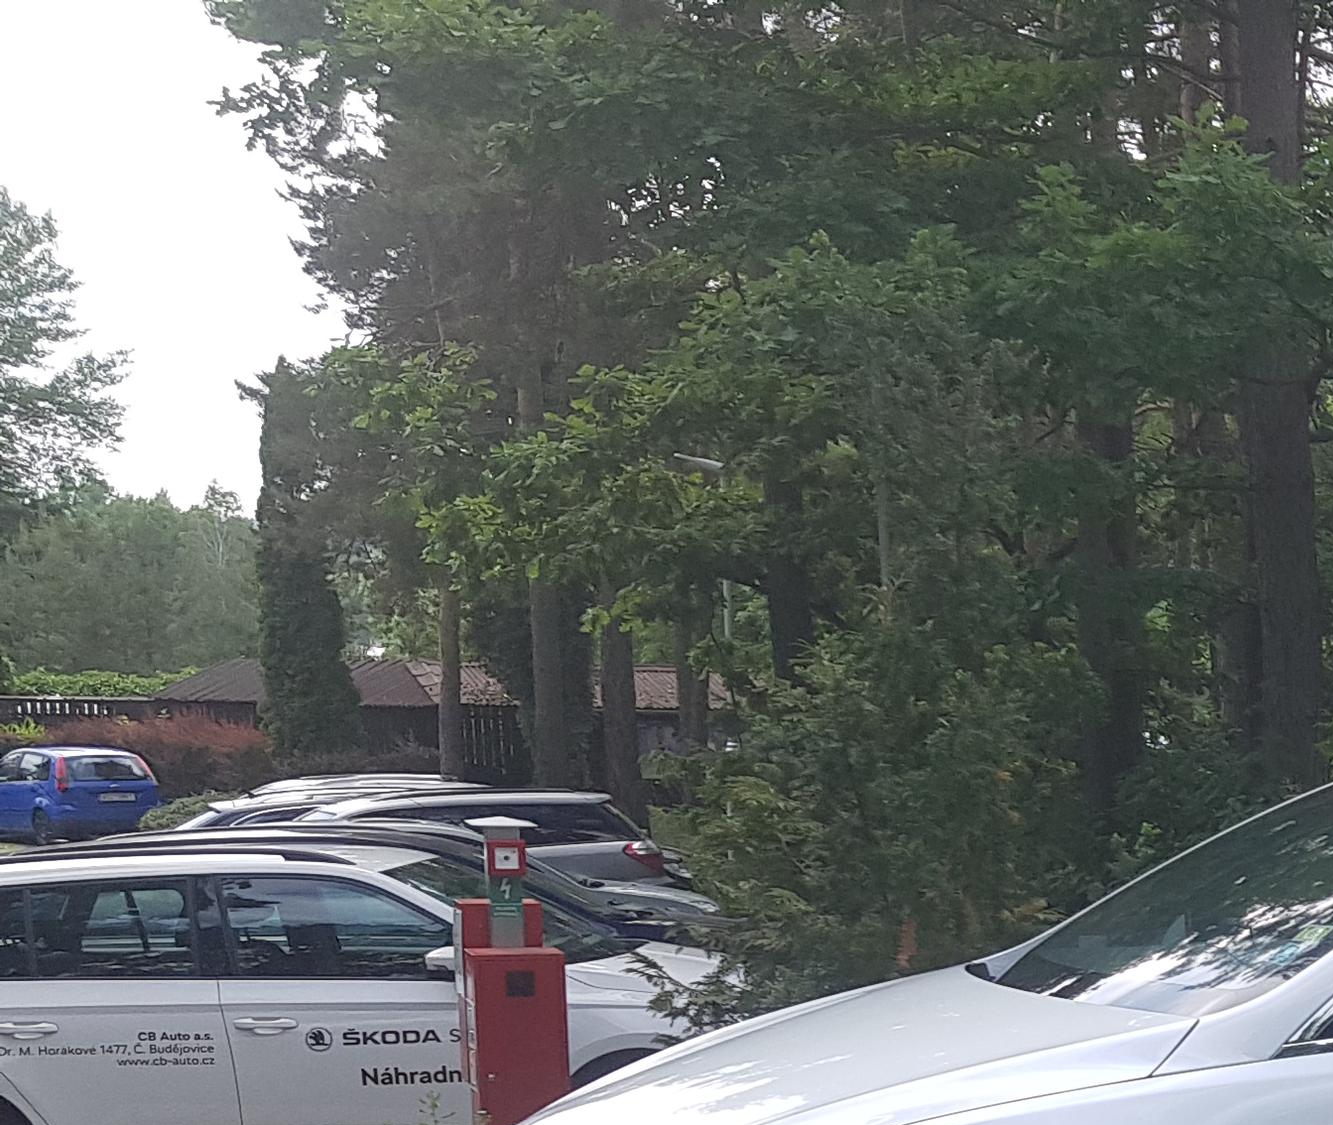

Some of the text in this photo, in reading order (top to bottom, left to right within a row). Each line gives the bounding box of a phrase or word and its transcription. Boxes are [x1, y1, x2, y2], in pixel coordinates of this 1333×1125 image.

[137, 1031, 214, 1042] CB Auto a.s.
[342, 1028, 442, 1046] ŠKODA
[149, 1044, 215, 1057] Budějovice
[117, 1055, 216, 1066] www.cb-auto.cz
